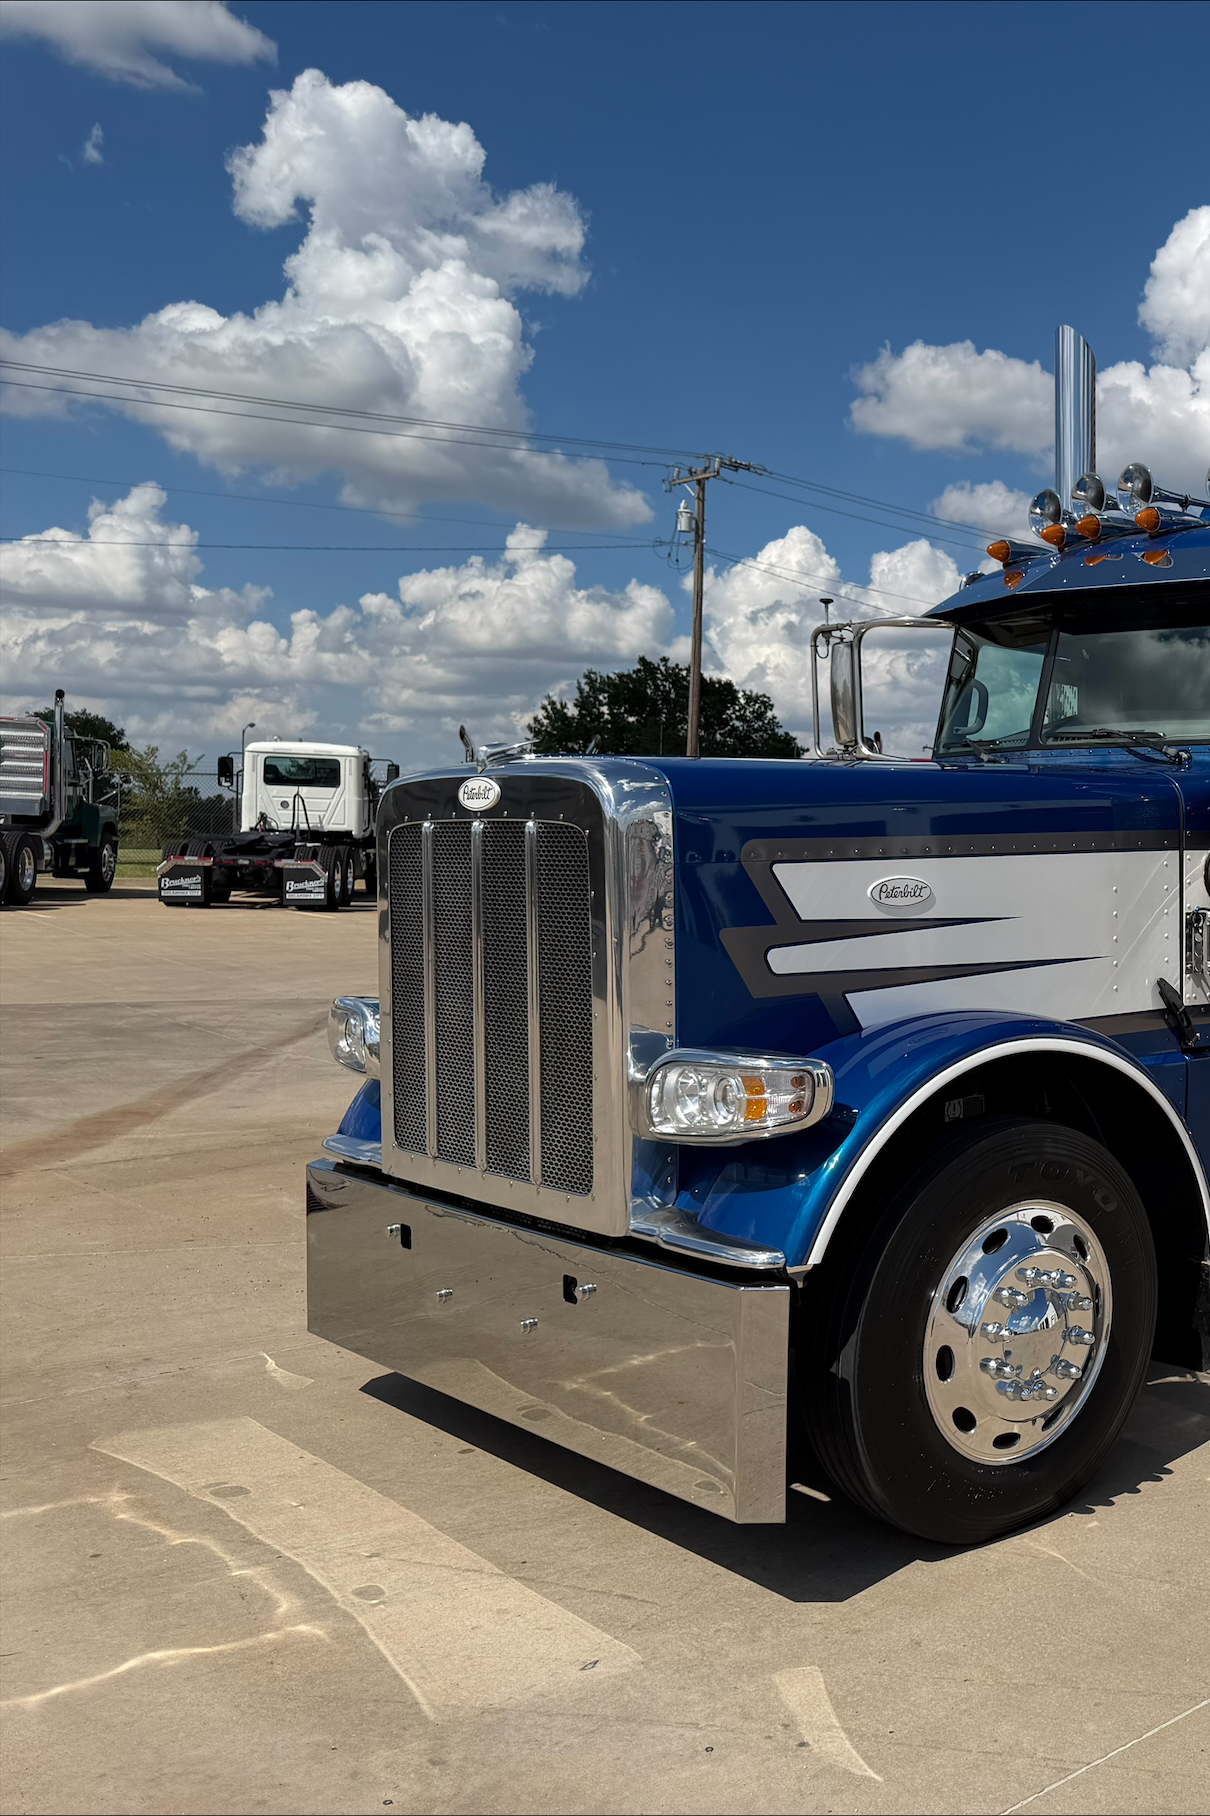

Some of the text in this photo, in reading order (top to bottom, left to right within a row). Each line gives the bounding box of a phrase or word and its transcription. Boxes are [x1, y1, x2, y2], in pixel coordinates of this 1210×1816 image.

[463, 784, 493, 802] Peterbilt
[878, 883, 928, 901] Peterbilt
[1007, 1160, 1118, 1212] TOYO
